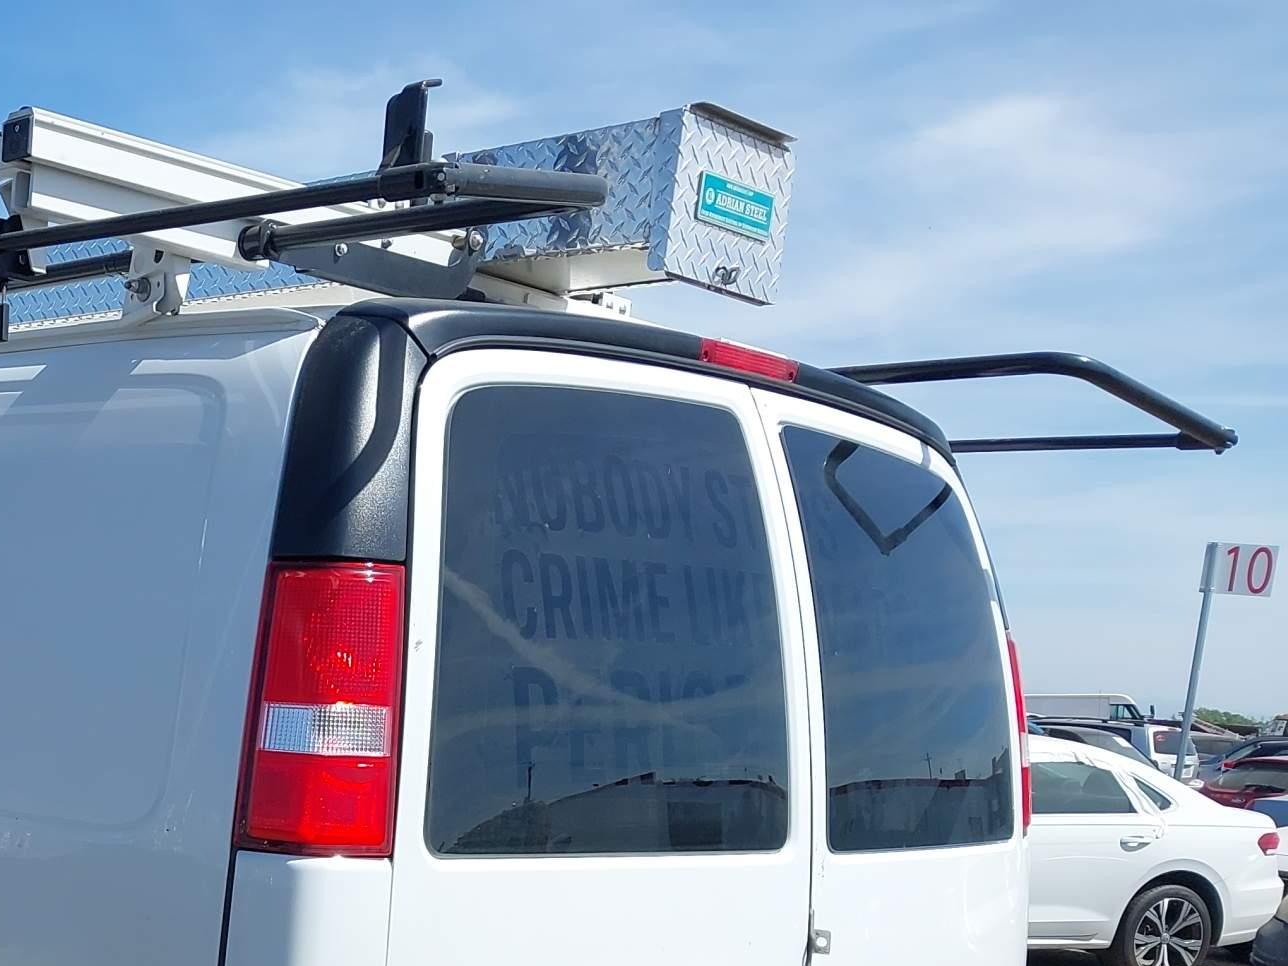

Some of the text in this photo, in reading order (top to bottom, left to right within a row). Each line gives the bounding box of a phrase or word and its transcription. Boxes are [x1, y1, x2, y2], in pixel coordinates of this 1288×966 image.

[715, 192, 768, 221] ADRIAN STEEL
[1227, 545, 1273, 594] 10
[500, 547, 675, 643] CRIME
